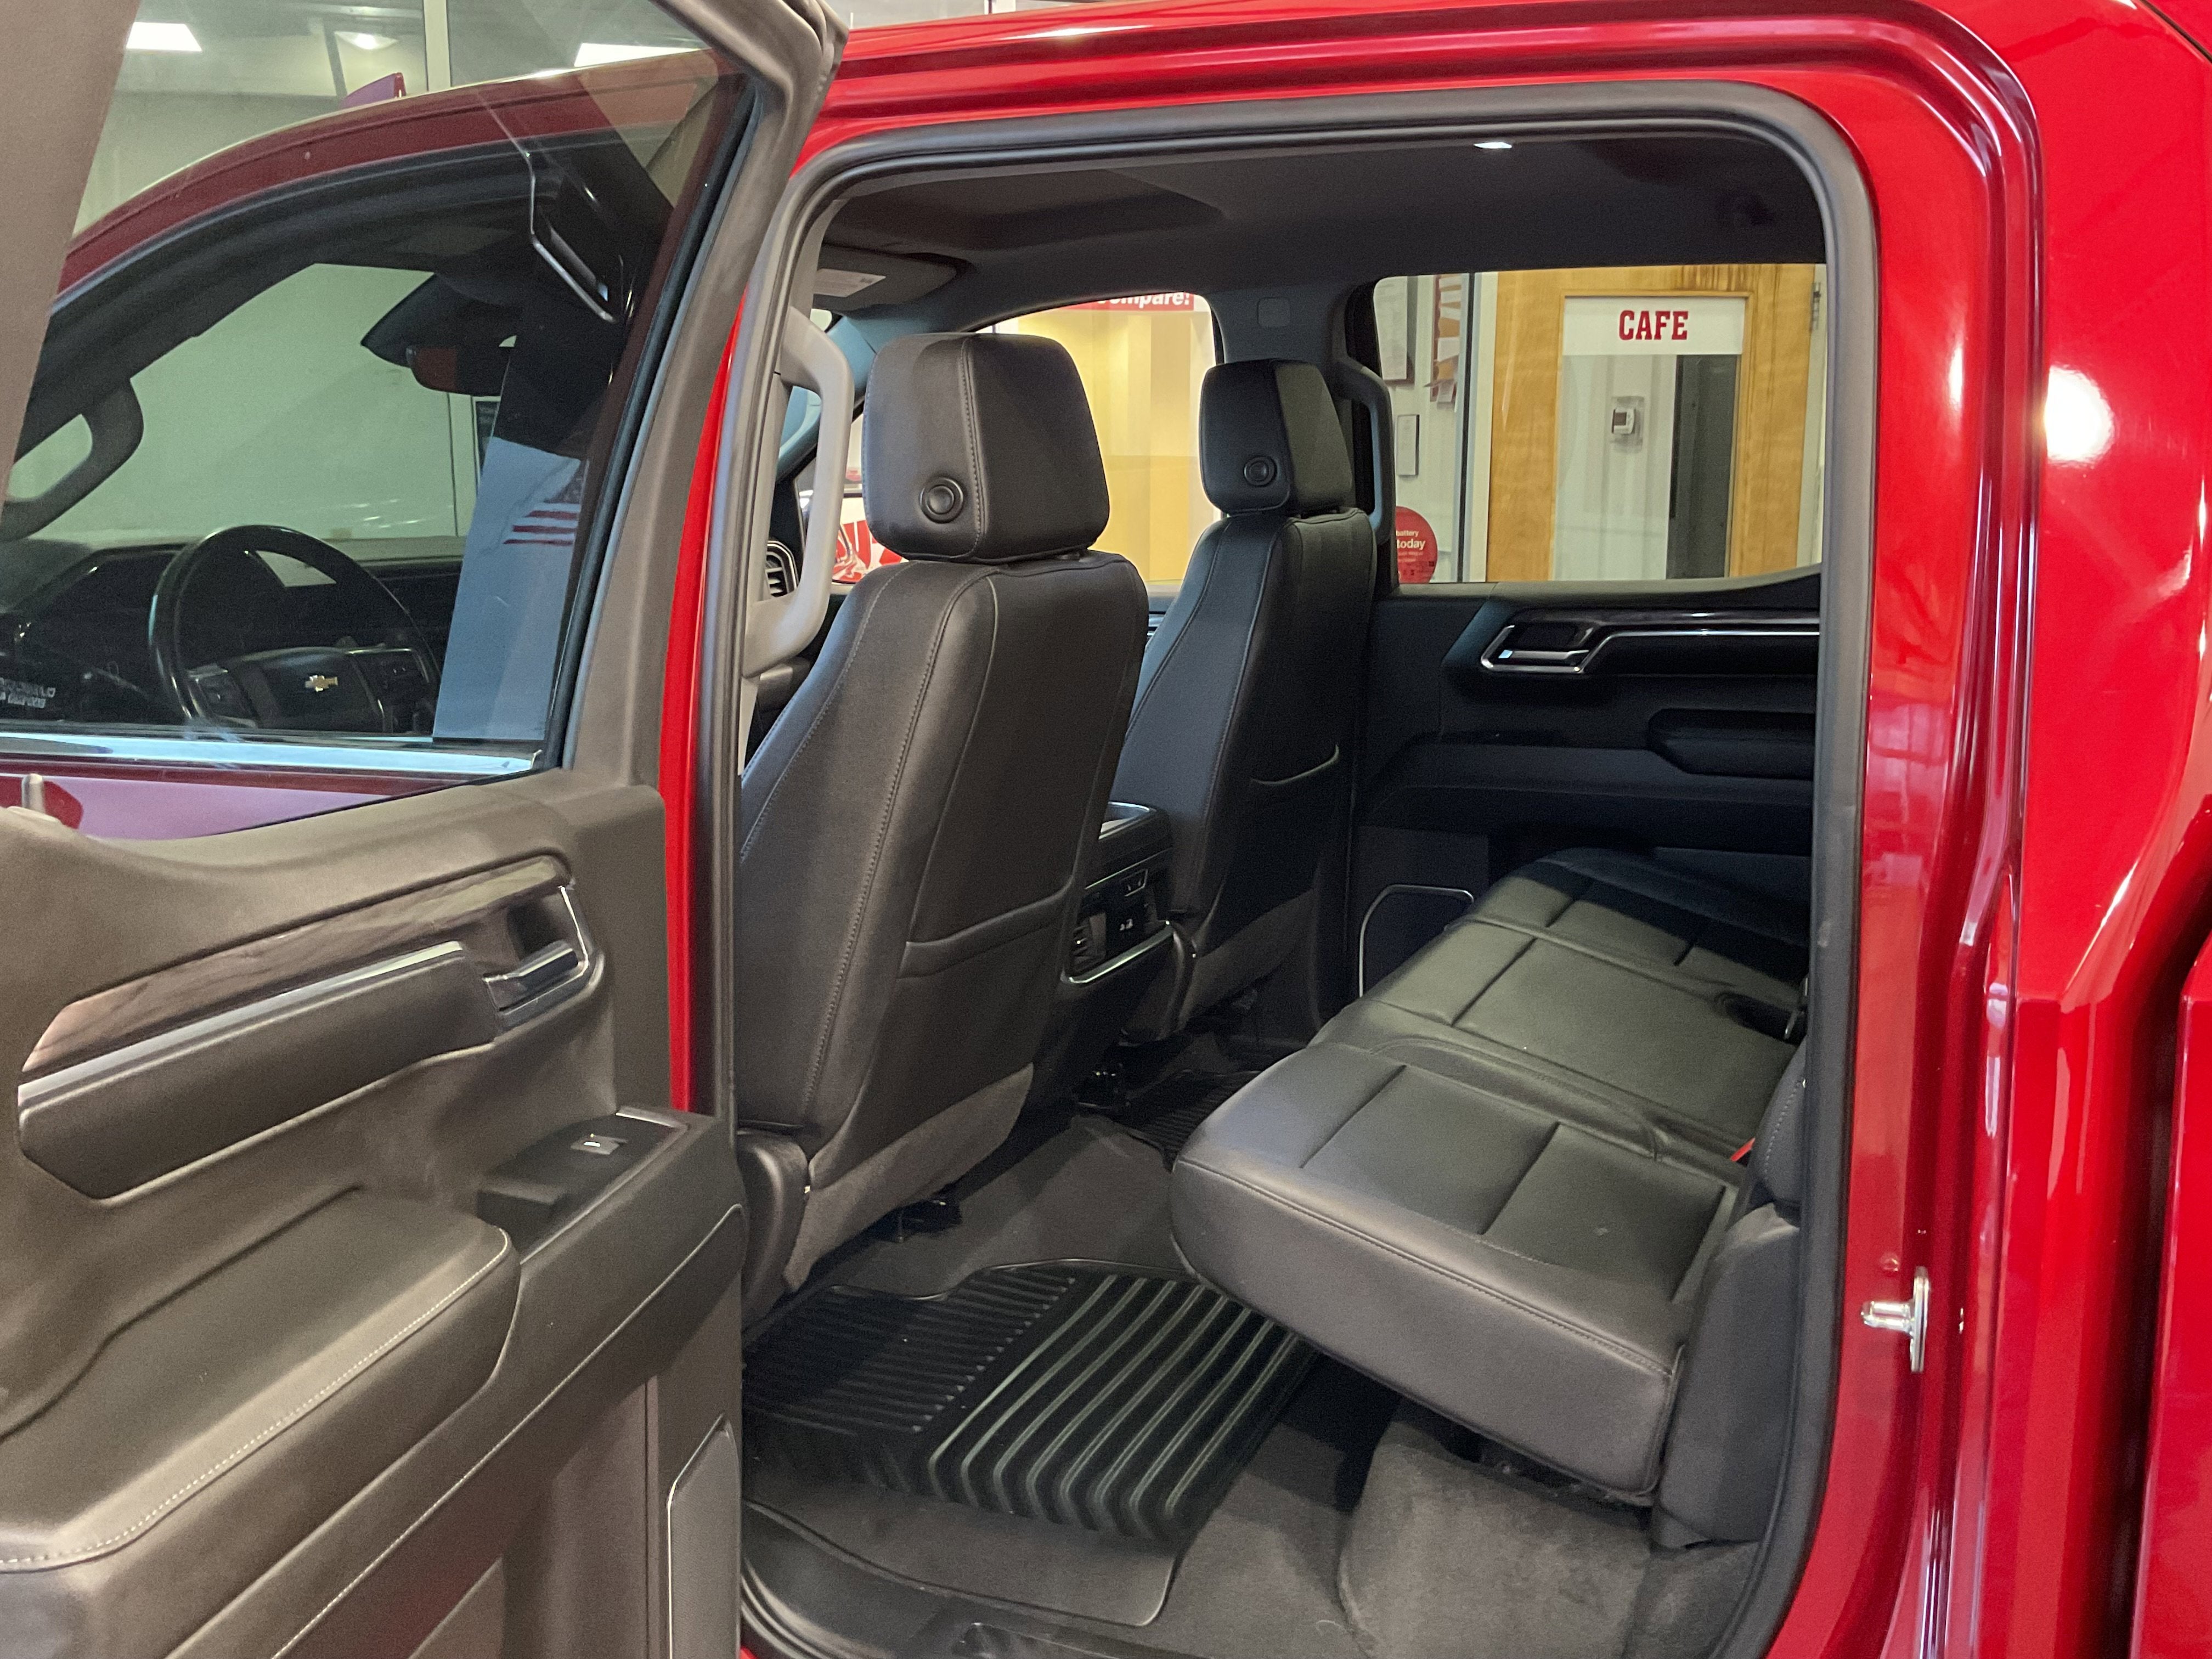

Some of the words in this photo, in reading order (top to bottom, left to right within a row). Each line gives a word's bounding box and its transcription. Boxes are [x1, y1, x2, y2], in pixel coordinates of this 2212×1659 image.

[1098, 292, 1189, 308] mpare!
[1619, 309, 1689, 340] CAFE
[1397, 538, 1426, 550] today
